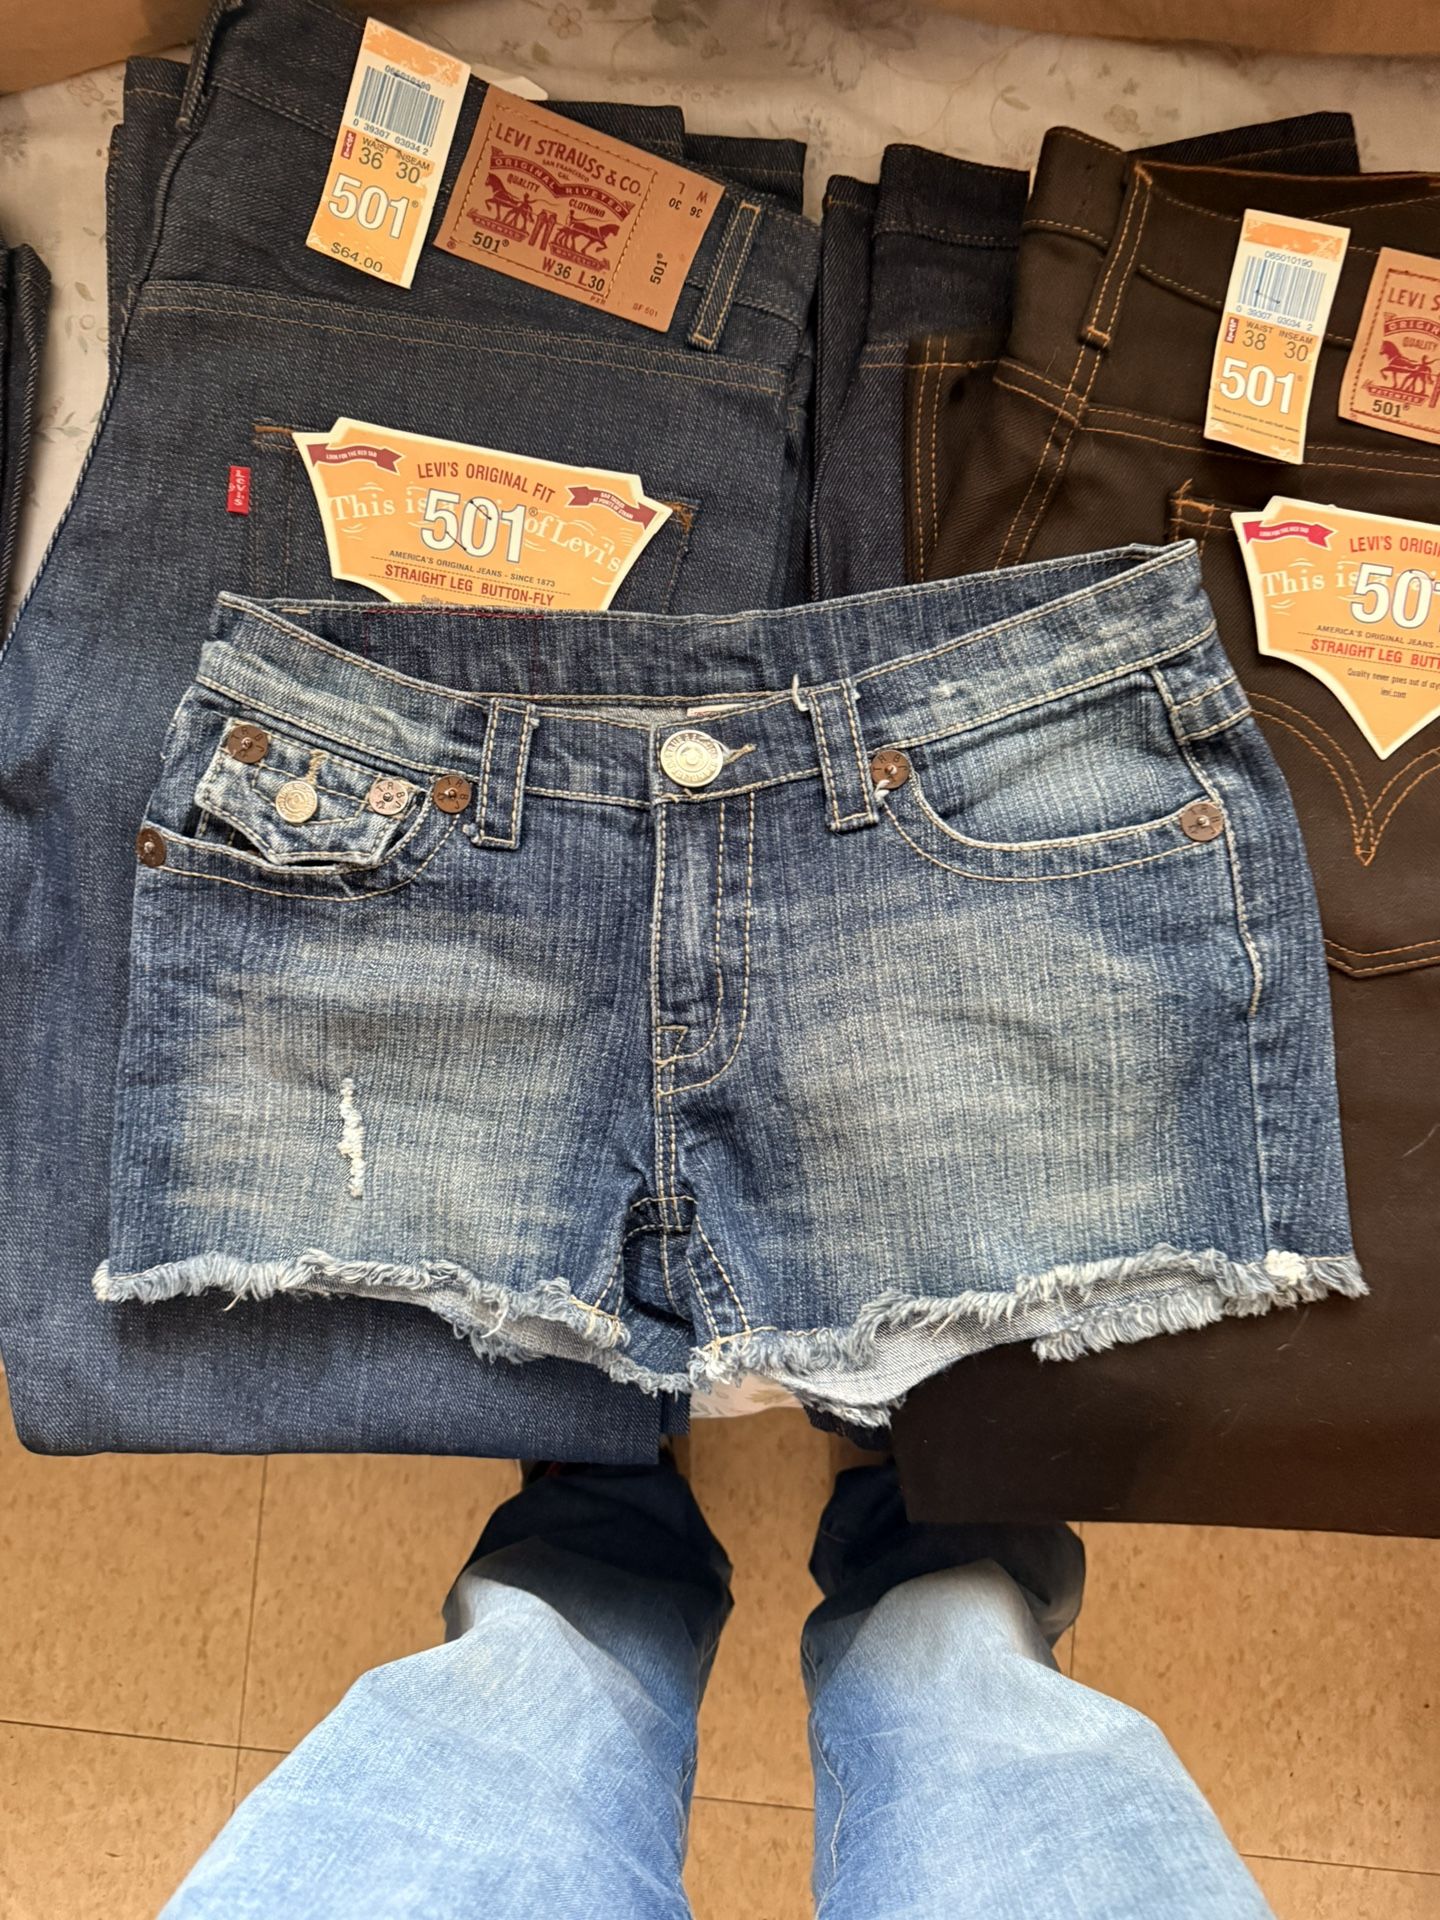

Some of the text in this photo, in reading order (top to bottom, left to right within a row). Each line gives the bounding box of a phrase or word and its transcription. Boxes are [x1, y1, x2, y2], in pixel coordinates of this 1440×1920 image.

[362, 136, 390, 155] WAIST
[495, 122, 642, 197] LEVI STRAUSS & CO.
[359, 147, 421, 184] 36 30
[495, 156, 623, 214] ORIGINAL RIVETED
[506, 173, 541, 193] QUALITY
[568, 199, 606, 218] CLOTHING
[669, 198, 703, 218] 30 36
[331, 242, 383, 273] $64.00
[542, 256, 572, 280] W36
[577, 271, 606, 292] L30
[1387, 286, 1426, 310] LEVI
[1242, 329, 1267, 351] 38
[1284, 340, 1309, 362] 30
[1246, 320, 1273, 334] WAIST
[1278, 330, 1314, 344] INSEAM
[417, 462, 556, 504] LEVI'S ORIGINAL FIT
[330, 493, 396, 521] This
[523, 511, 621, 573] of Levi's
[1350, 535, 1393, 553] LEVI'S
[388, 549, 434, 565] AMERICA'S
[436, 559, 474, 573] ORIGINAL
[476, 567, 502, 578] JEANS
[510, 573, 534, 584] SINCE
[537, 578, 556, 588] 1873
[384, 564, 555, 607] STRAIGHT LEG BUTTON-FLY
[1261, 569, 1326, 598] This
[1316, 624, 1363, 638] AMERICA'S
[1364, 631, 1404, 644] ORIGINAL
[1407, 638, 1434, 648] JEANS
[1311, 638, 1375, 659] STRAIGHT
[1378, 648, 1403, 663] LEG
[1347, 667, 1370, 680] Quality
[1372, 671, 1389, 681] never
